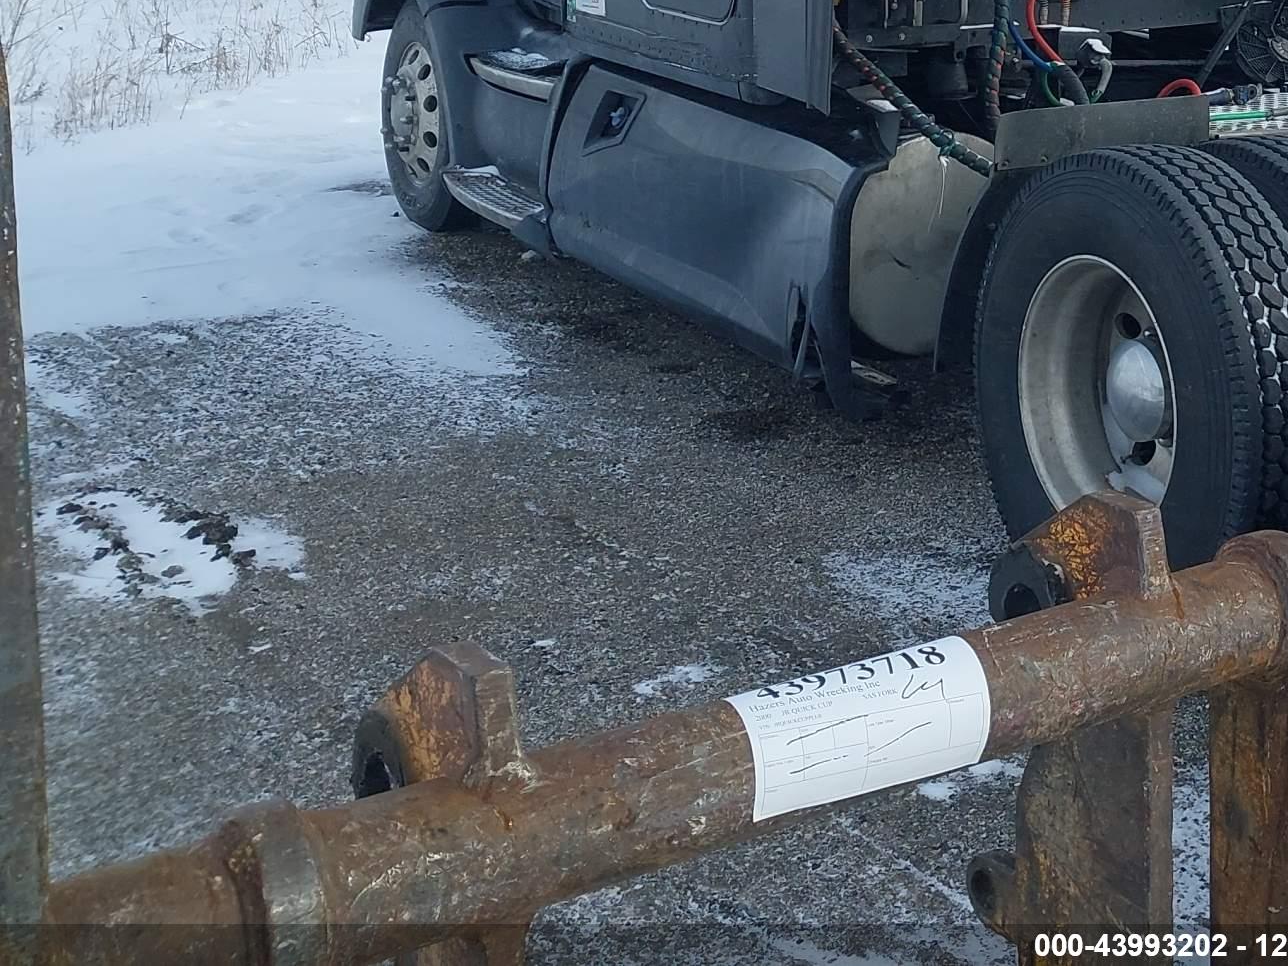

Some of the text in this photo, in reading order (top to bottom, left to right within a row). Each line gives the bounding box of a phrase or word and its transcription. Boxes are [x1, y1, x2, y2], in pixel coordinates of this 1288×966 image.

[757, 646, 945, 698] 43973718
[788, 695, 813, 705] Auto
[814, 683, 863, 698] Wrecking
[864, 679, 881, 690] Inc
